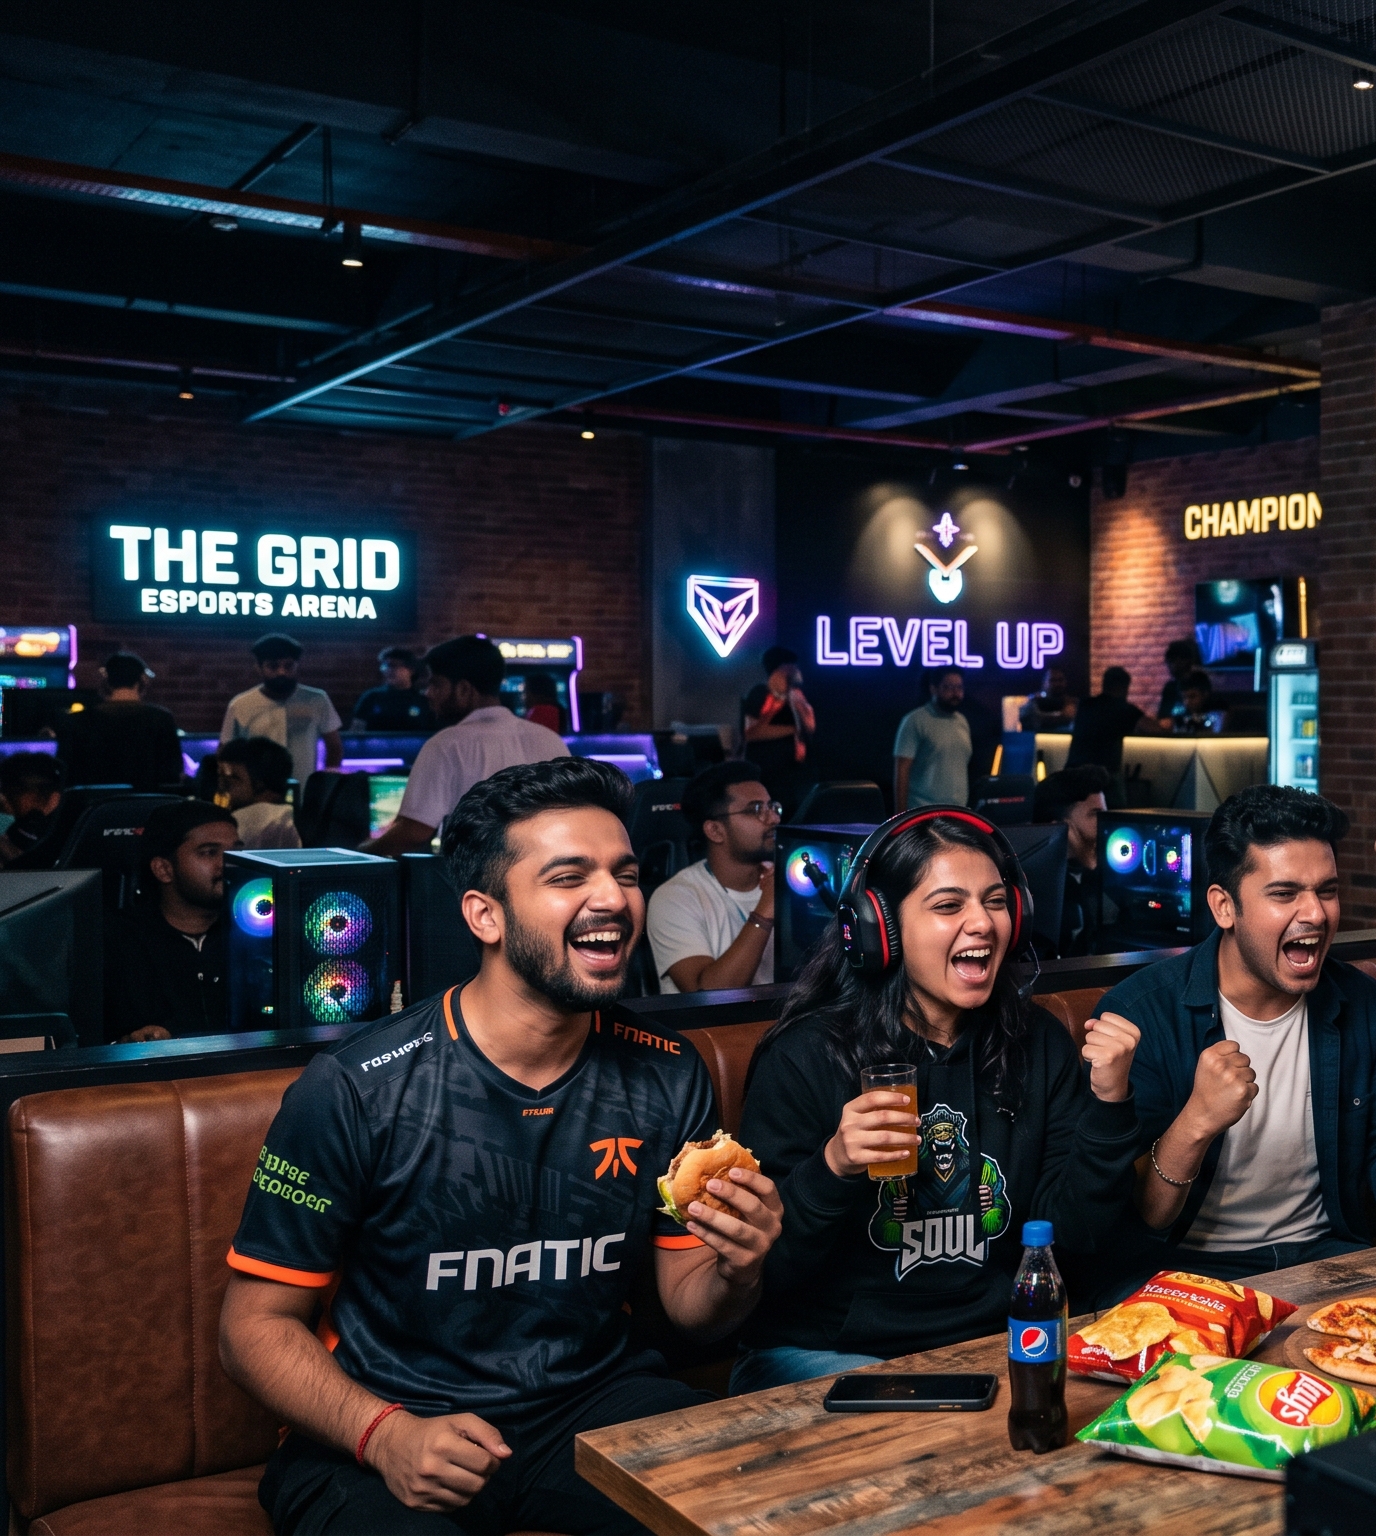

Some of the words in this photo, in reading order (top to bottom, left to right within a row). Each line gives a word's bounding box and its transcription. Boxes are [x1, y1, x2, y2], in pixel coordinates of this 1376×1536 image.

[108, 524, 240, 586] THE
[256, 533, 401, 592] GRID
[141, 587, 275, 618] ESPORTS
[281, 592, 378, 620] ARENA
[816, 614, 983, 668] LEVEL
[995, 621, 1065, 670] UP
[613, 1021, 681, 1055] FNATIC
[425, 1231, 627, 1292] FNATIC
[900, 1213, 985, 1272] SOUL
